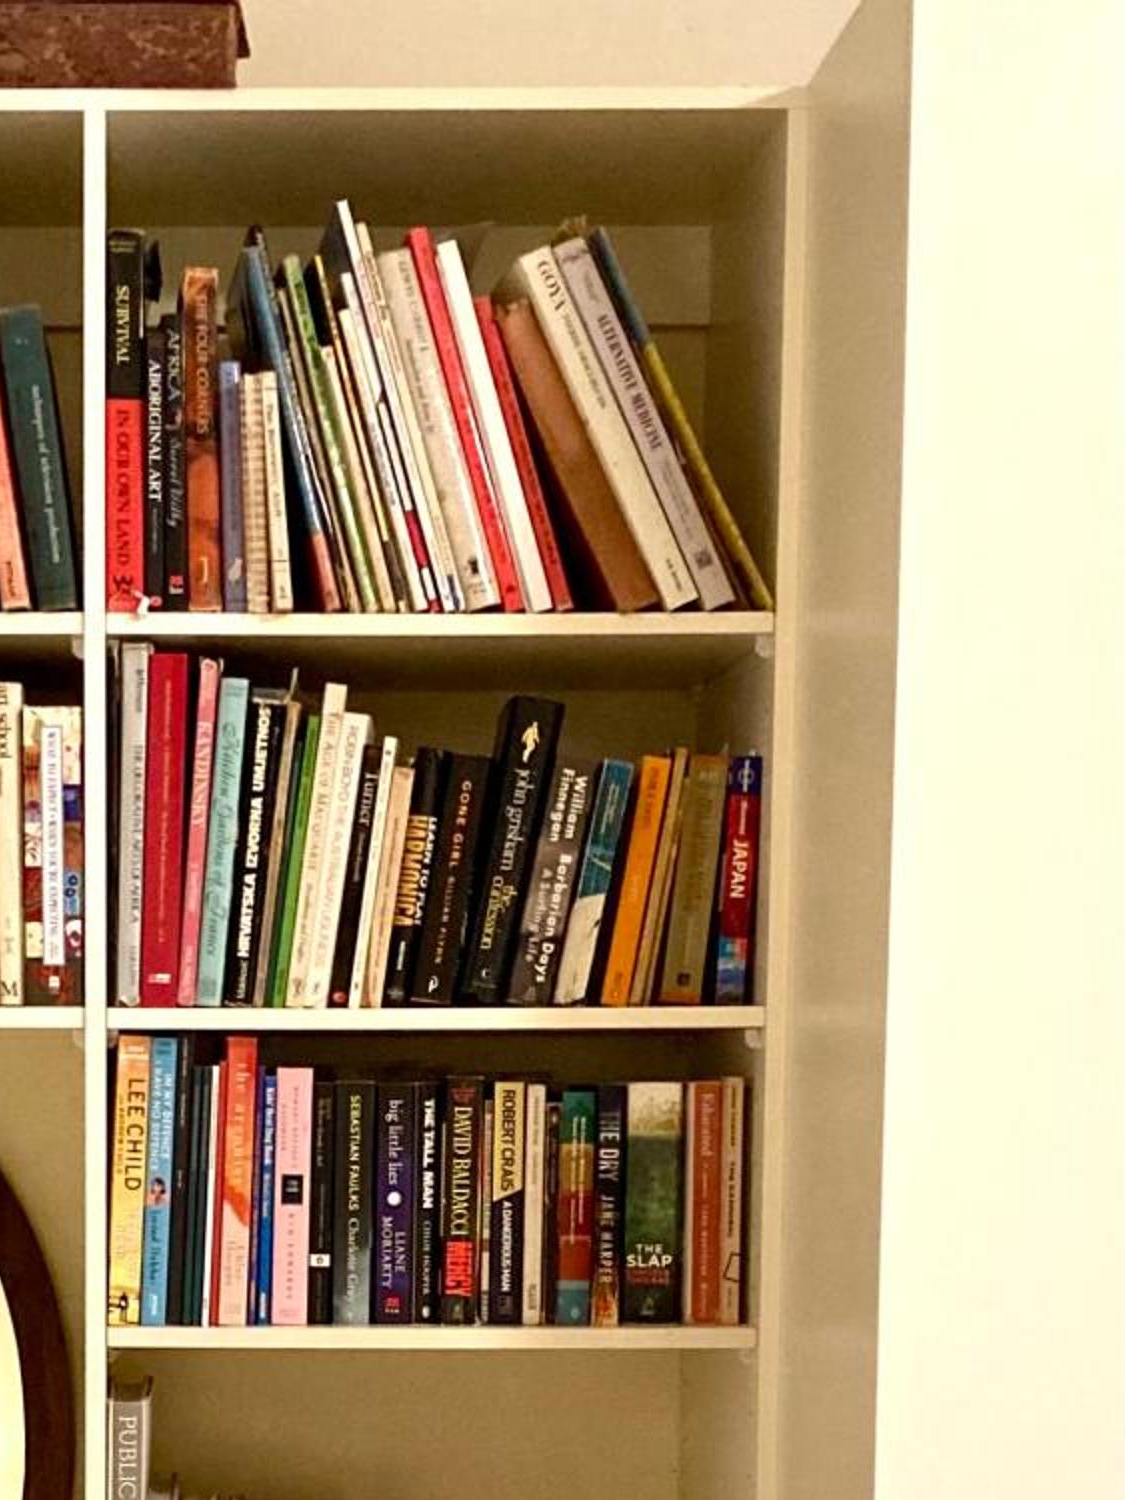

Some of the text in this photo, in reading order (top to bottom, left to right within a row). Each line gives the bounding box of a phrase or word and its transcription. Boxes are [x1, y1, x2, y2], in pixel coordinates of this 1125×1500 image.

[534, 261, 570, 315] GOYA
[166, 328, 182, 402] AFRICA
[194, 325, 209, 435] FOUR CORNERS
[595, 312, 665, 452] ALTERNATIVE MEDICINE
[115, 285, 131, 567] SURVIVAL IN OUR OWN LAND
[146, 359, 163, 505] ABORIGINAL ART
[47, 731, 58, 760] WHAT
[190, 720, 215, 829] KANDINSKY
[219, 721, 242, 798] Kitchen
[358, 770, 382, 827] Turner
[454, 780, 473, 826] GONE
[499, 767, 536, 872] john grisham
[549, 767, 577, 844] Finnegan
[562, 775, 589, 840] William
[236, 797, 265, 958] HRVATSKA IZVORNA
[393, 815, 431, 927] HARMONICA
[417, 816, 438, 889] LEARN TO
[447, 833, 465, 867] GIRL
[730, 838, 750, 900] JAPAN
[478, 875, 506, 951] confession
[500, 884, 518, 905] the
[524, 867, 554, 965] A Surfing Life
[534, 853, 573, 985] Barbarian Days
[235, 1062, 253, 1090] the
[422, 1098, 436, 1127] THE
[123, 1078, 147, 1191] LEE CHILD
[347, 1094, 362, 1161] SEBASTIAN
[383, 1098, 404, 1186] big little lies
[421, 1129, 435, 1168] TALL
[699, 1092, 718, 1158] Educated
[346, 1165, 361, 1210] FAULKS
[420, 1170, 435, 1209] MAN
[445, 1105, 474, 1296] DAVID BALDACCI MERCY
[498, 1088, 518, 1292] ROBERT CRAIS A DANGEROUS MAN
[597, 1110, 621, 1284] THE DRY JANE HARPER
[345, 1217, 361, 1270] Charlotte
[379, 1215, 395, 1289] MORIARTY
[392, 1230, 408, 1273] LIANE
[625, 1254, 673, 1268] SLAP
[626, 1243, 665, 1254] THE
[117, 1415, 139, 1499] PUBLIC
